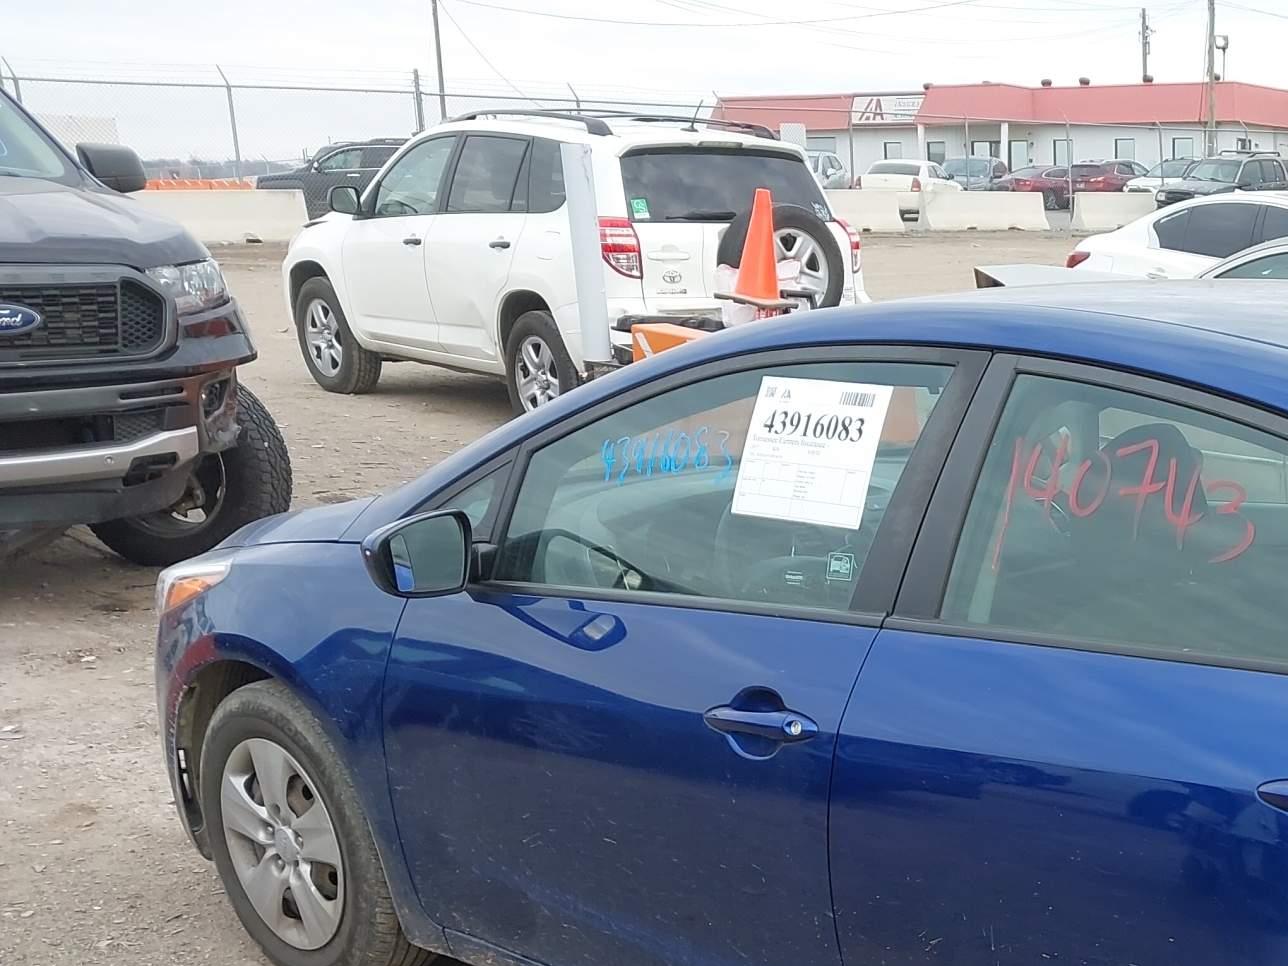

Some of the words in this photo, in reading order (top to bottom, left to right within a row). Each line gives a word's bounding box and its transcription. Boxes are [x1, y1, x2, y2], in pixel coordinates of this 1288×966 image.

[763, 409, 865, 442] 43916083
[601, 426, 735, 488] 43916083
[991, 436, 1256, 577] 140743
